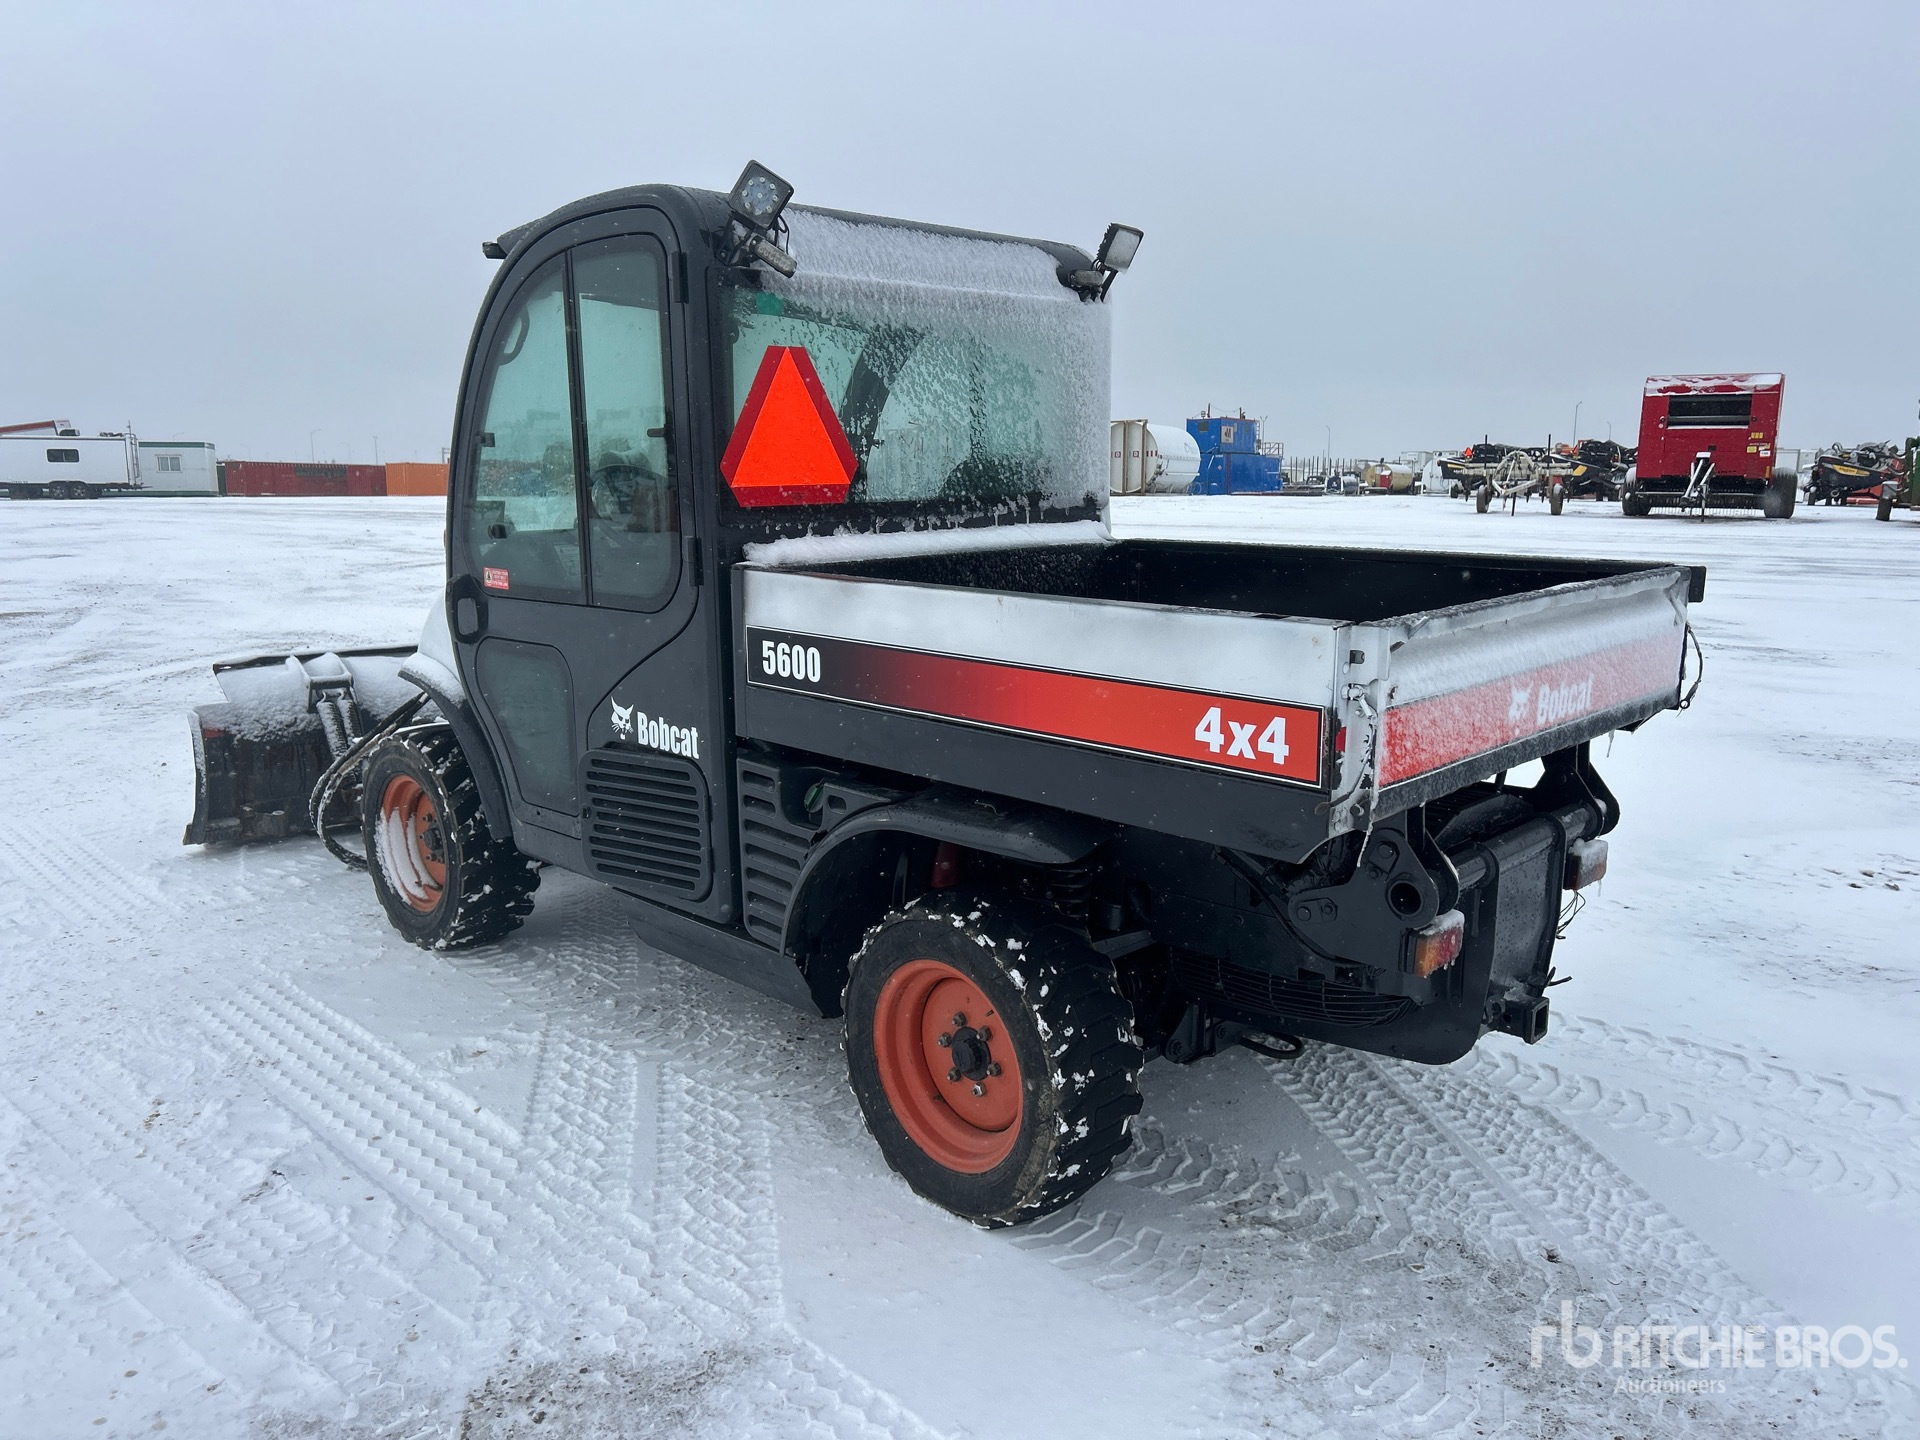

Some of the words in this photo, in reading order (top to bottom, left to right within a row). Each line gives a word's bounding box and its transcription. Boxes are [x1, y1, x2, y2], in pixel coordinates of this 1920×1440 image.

[762, 640, 821, 682] 5600
[1537, 673, 1594, 725] Bobcat
[637, 711, 699, 759] Bobcat
[1195, 706, 1289, 765] 4x4
